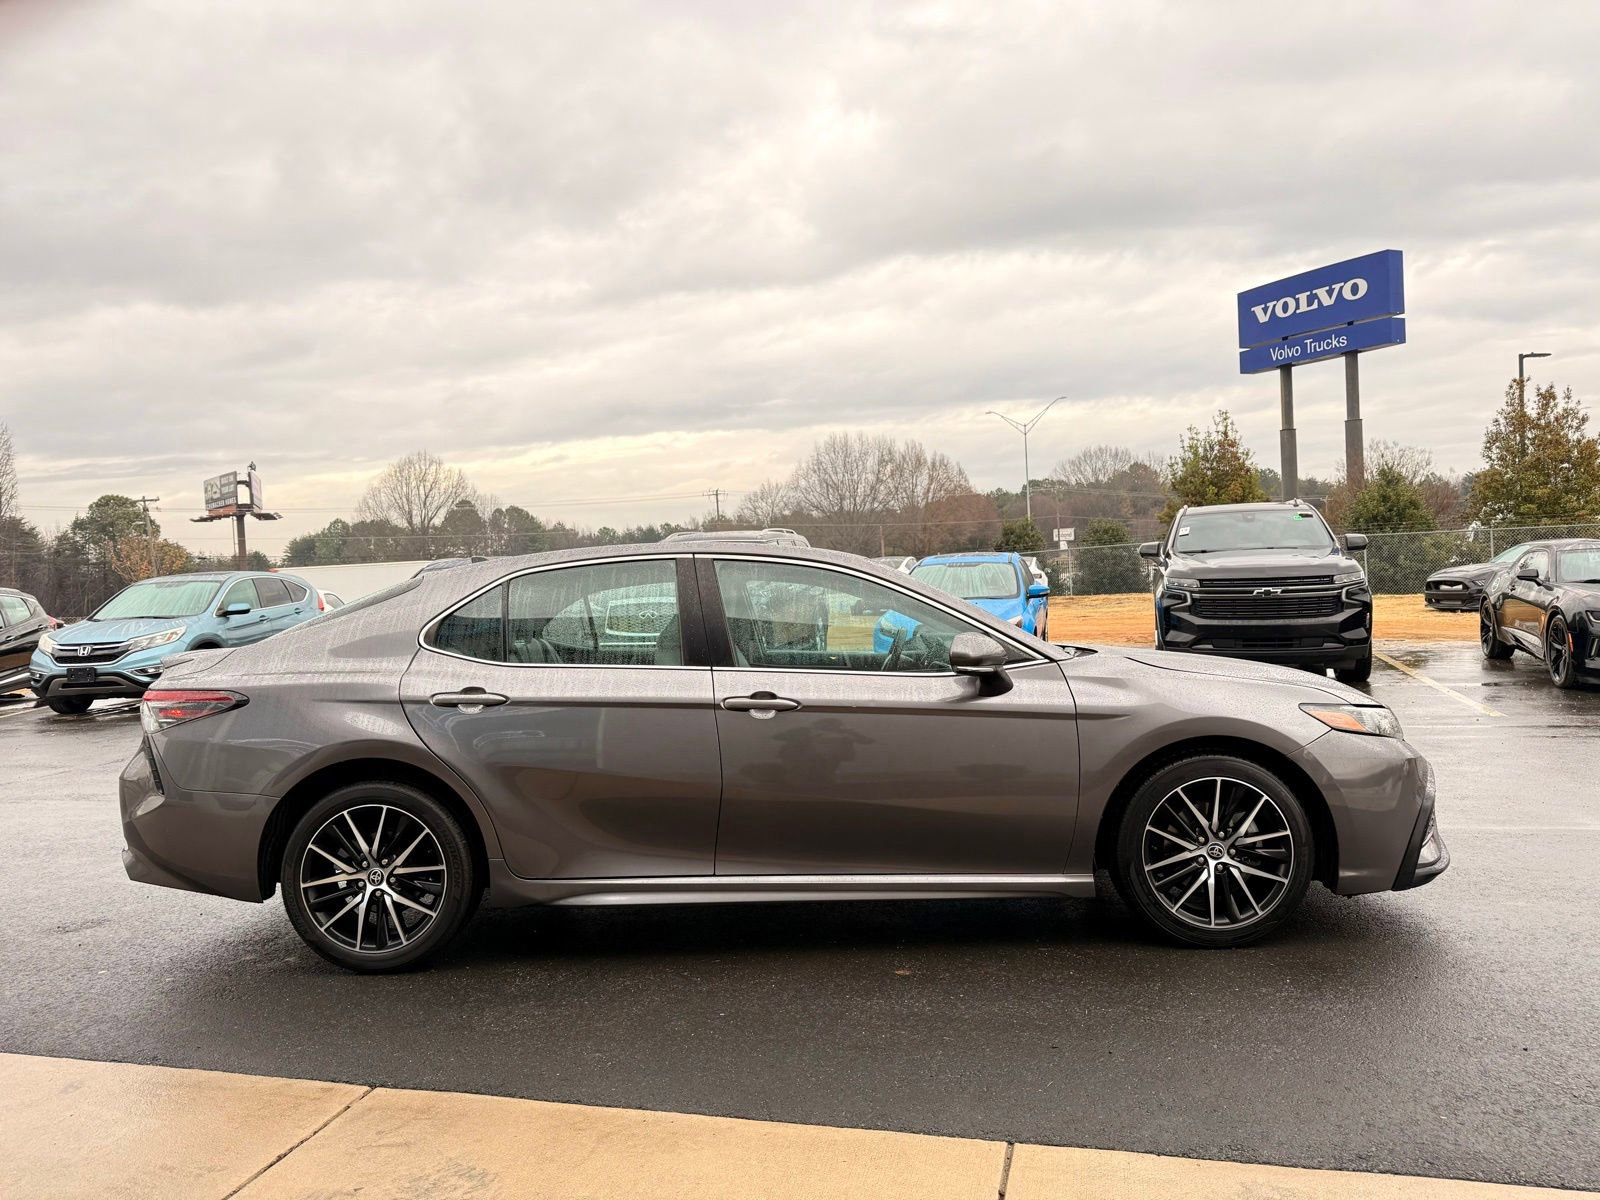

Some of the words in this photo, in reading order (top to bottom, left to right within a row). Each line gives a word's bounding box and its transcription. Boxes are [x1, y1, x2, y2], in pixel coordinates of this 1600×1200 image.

[1251, 278, 1368, 323] VOLVO
[1269, 344, 1301, 361] Volvo
[1304, 333, 1348, 354] Trucks
